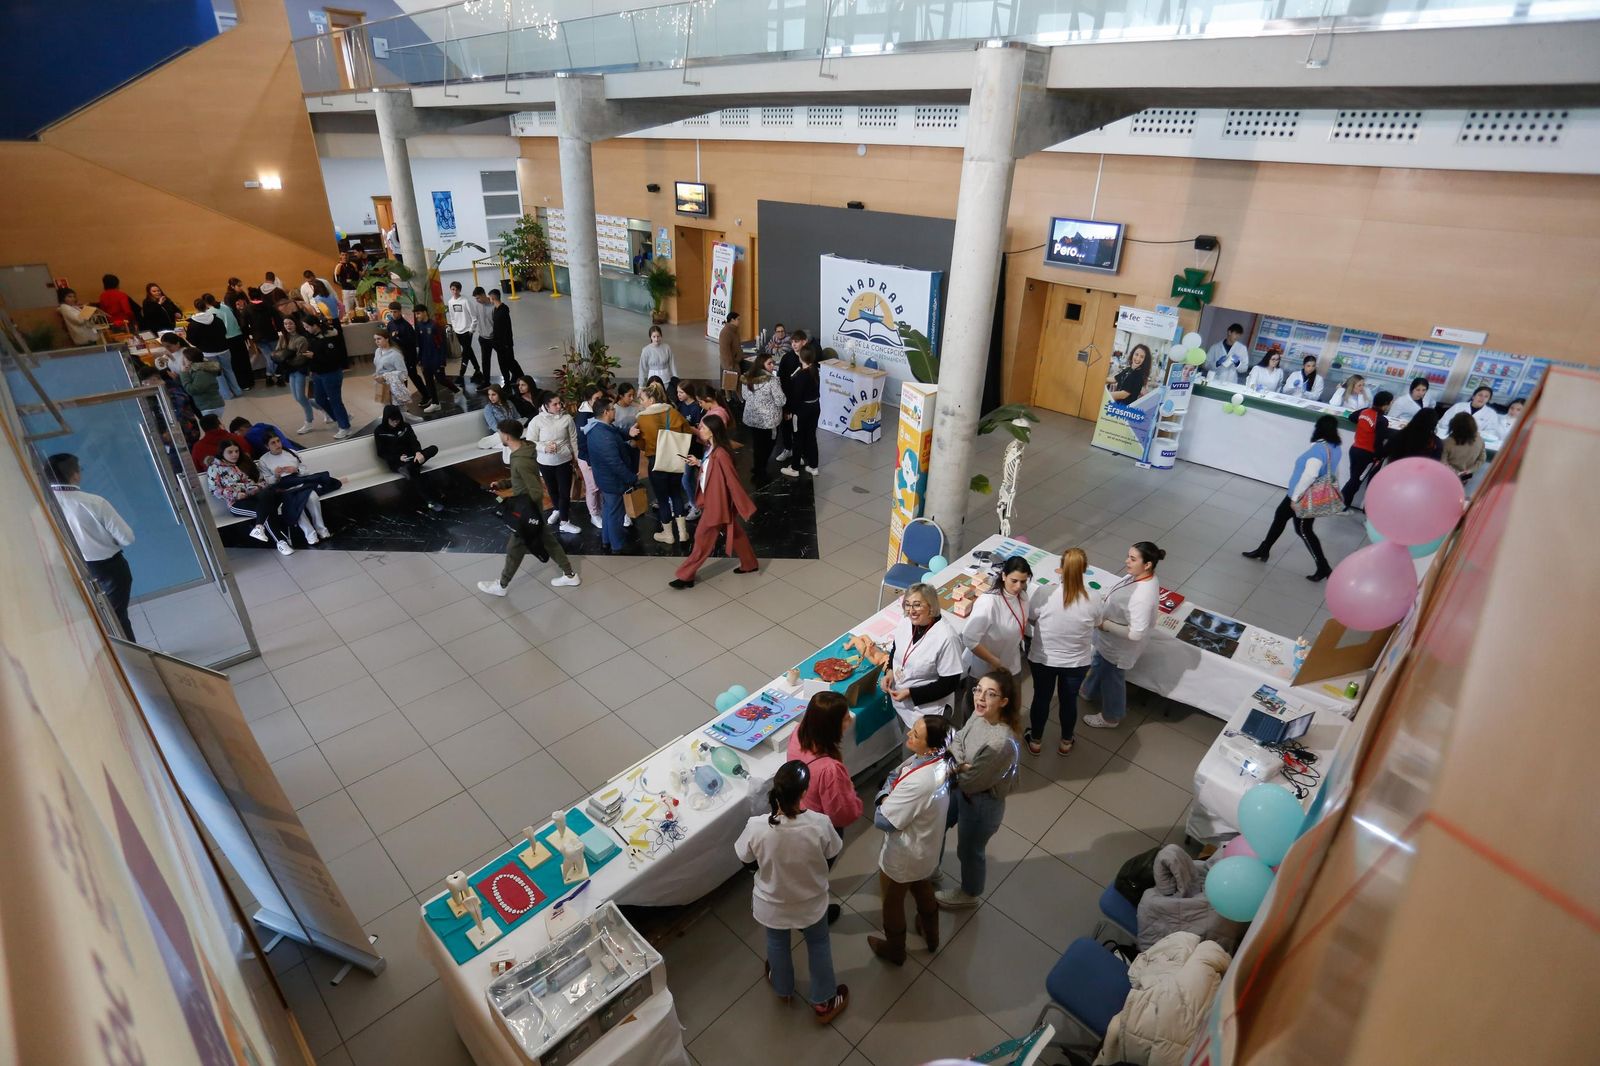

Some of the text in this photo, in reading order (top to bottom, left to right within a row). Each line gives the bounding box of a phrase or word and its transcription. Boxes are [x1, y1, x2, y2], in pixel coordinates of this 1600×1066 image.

[1053, 243, 1085, 258] Pero...
[1177, 286, 1204, 295] FARMACIA
[711, 298, 726, 310] EDUCA
[1129, 312, 1140, 322] fec
[863, 342, 870, 350] LA
[870, 343, 905, 358] CONCEPCIÓ
[1107, 405, 1145, 421] Erasmus+
